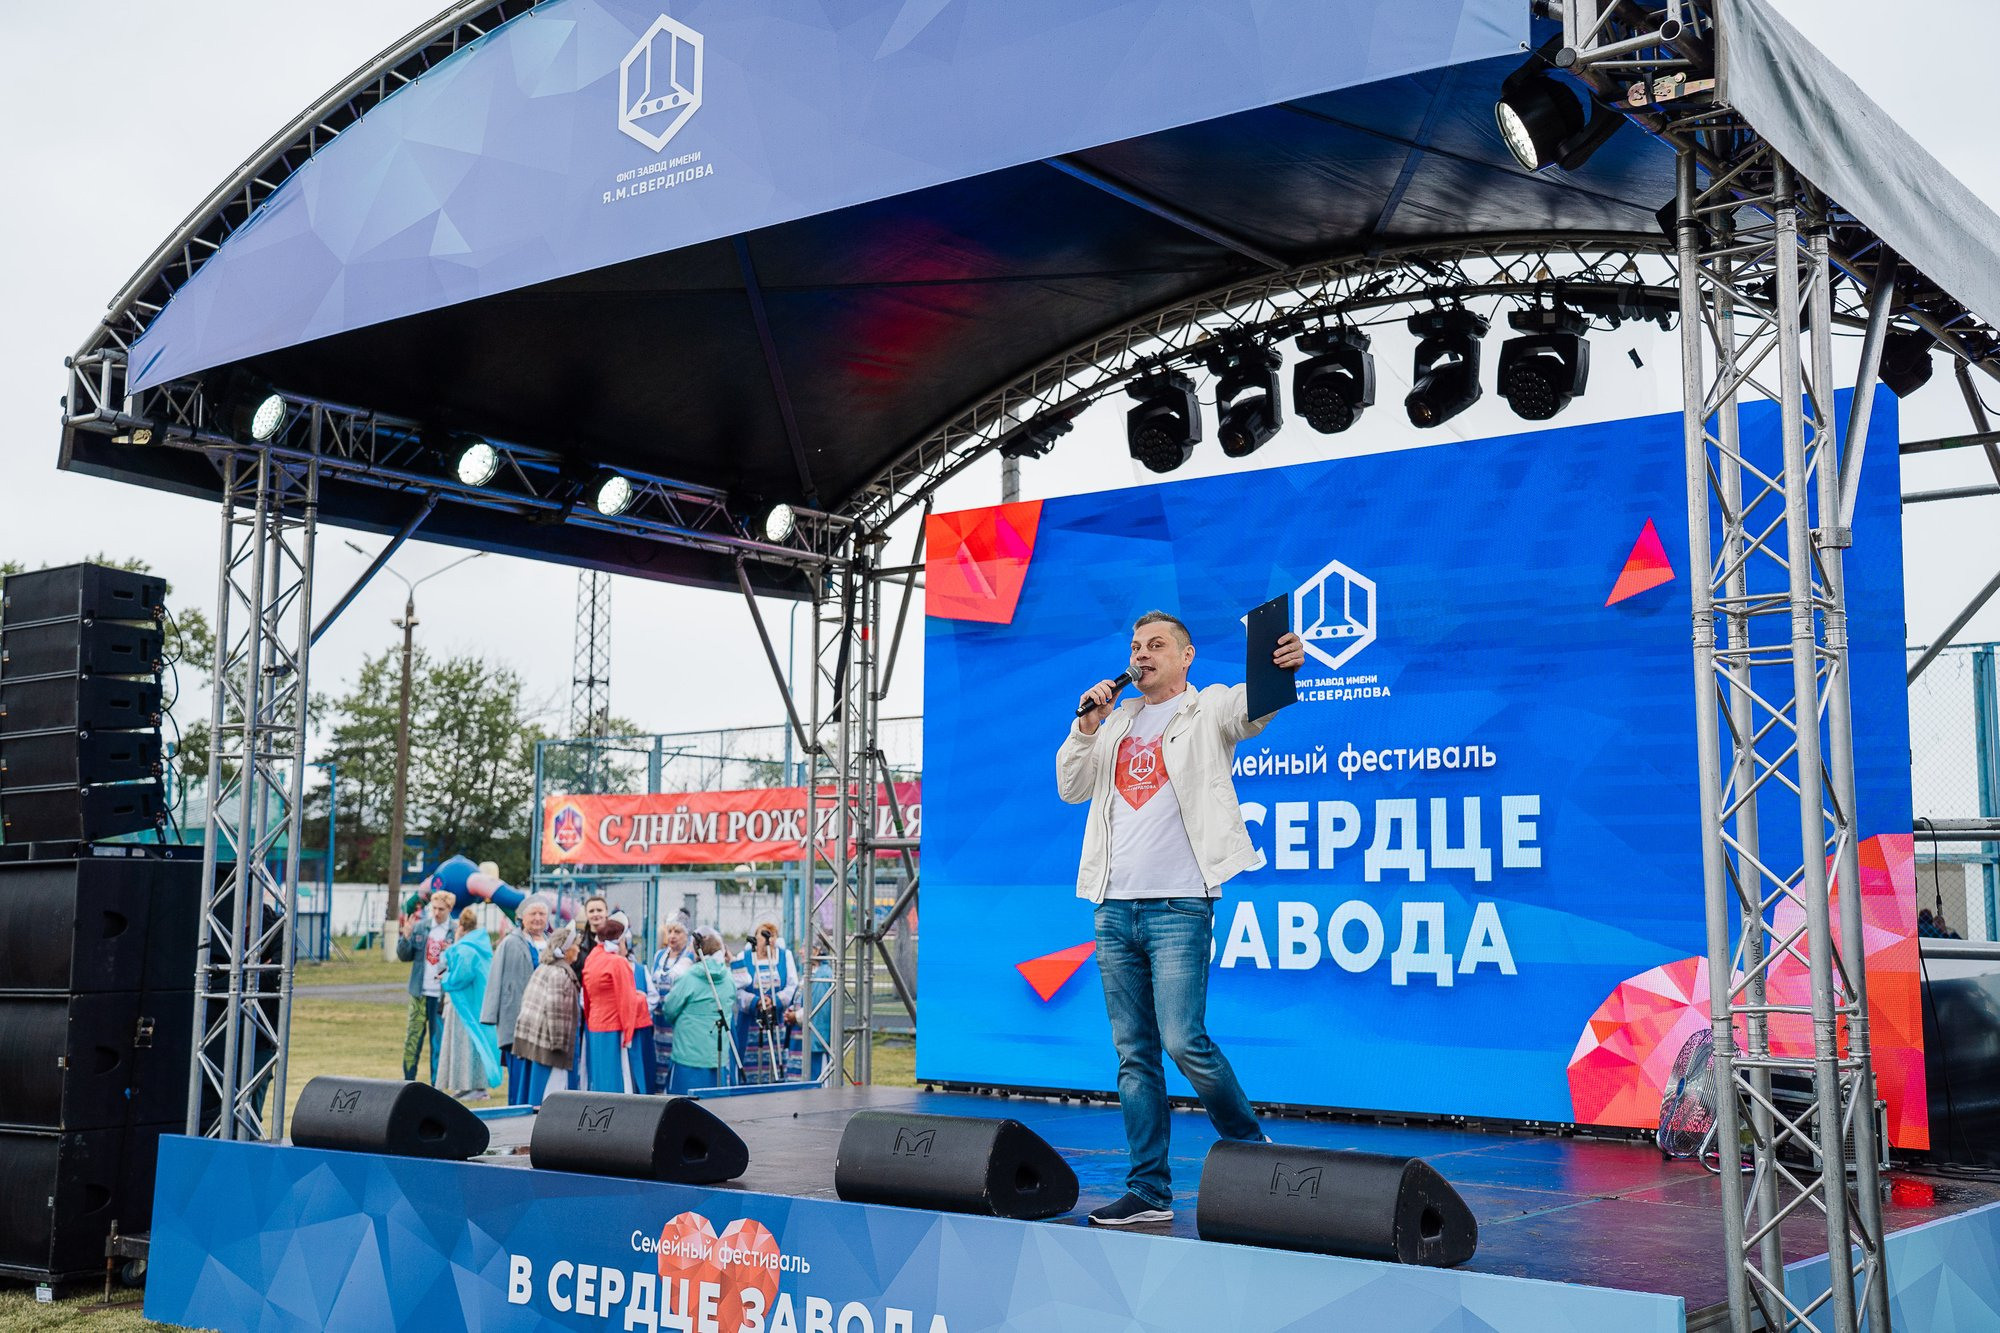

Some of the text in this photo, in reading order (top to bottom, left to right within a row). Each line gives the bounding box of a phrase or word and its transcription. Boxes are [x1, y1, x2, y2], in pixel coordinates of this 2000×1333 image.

[602, 163, 714, 204] Я.М.СВЕРДЛОВА
[616, 151, 702, 183] ФКП ЗАВОД ИМЕНИ
[1315, 677, 1344, 687] ЗАВОД
[1346, 675, 1377, 684] ИМЕНИ
[1232, 742, 1497, 780] мейный фестиваль
[599, 814, 622, 846] С
[624, 807, 720, 853] ДНЁМ
[1210, 900, 1518, 987] АВОДА
[631, 1229, 811, 1274] Семейный фестиваль
[507, 1254, 532, 1305] В
[547, 1260, 720, 1333] СЕРДЦЕ
